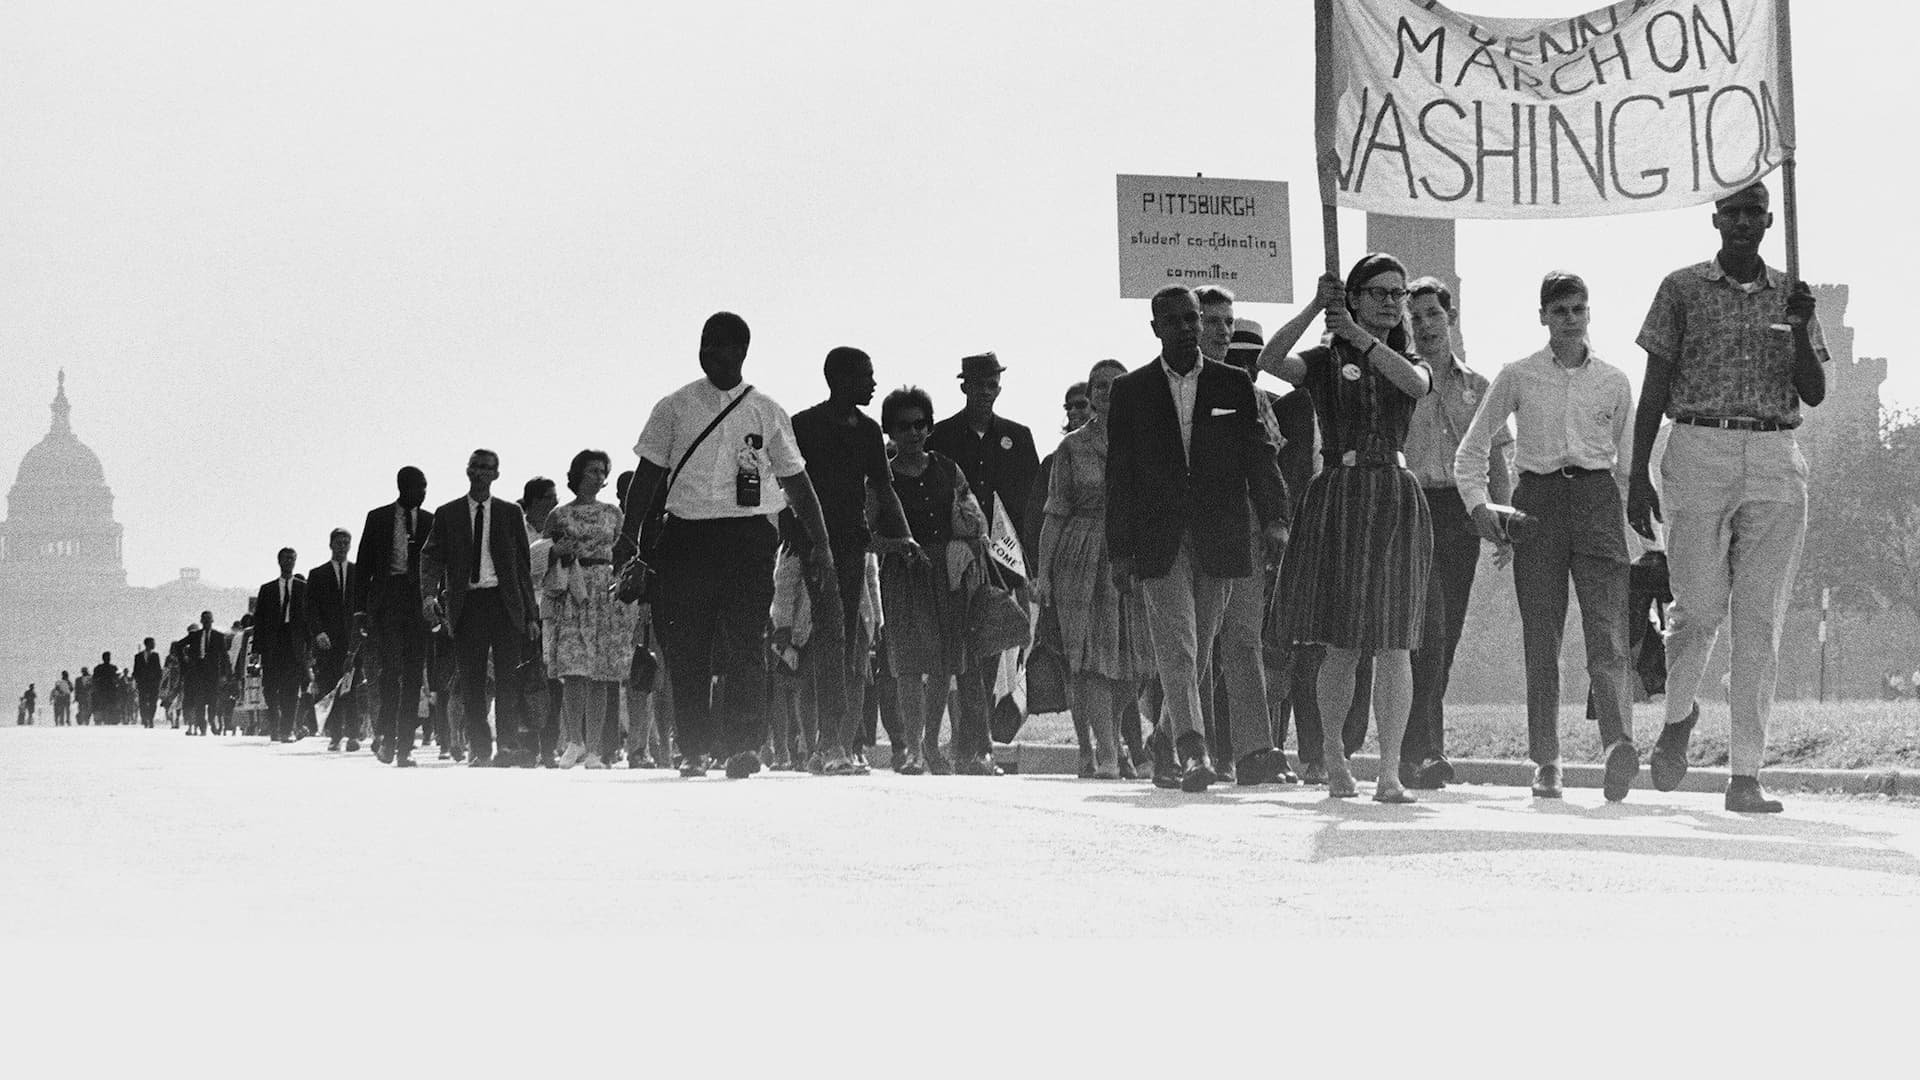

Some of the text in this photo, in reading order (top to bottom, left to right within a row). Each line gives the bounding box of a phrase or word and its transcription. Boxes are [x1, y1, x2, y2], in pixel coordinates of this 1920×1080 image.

[1392, 0, 1738, 97] MARCH ON
[1142, 192, 1256, 217] PITTSBURGH
[1130, 231, 1181, 246] student
[1166, 263, 1239, 280] committee
